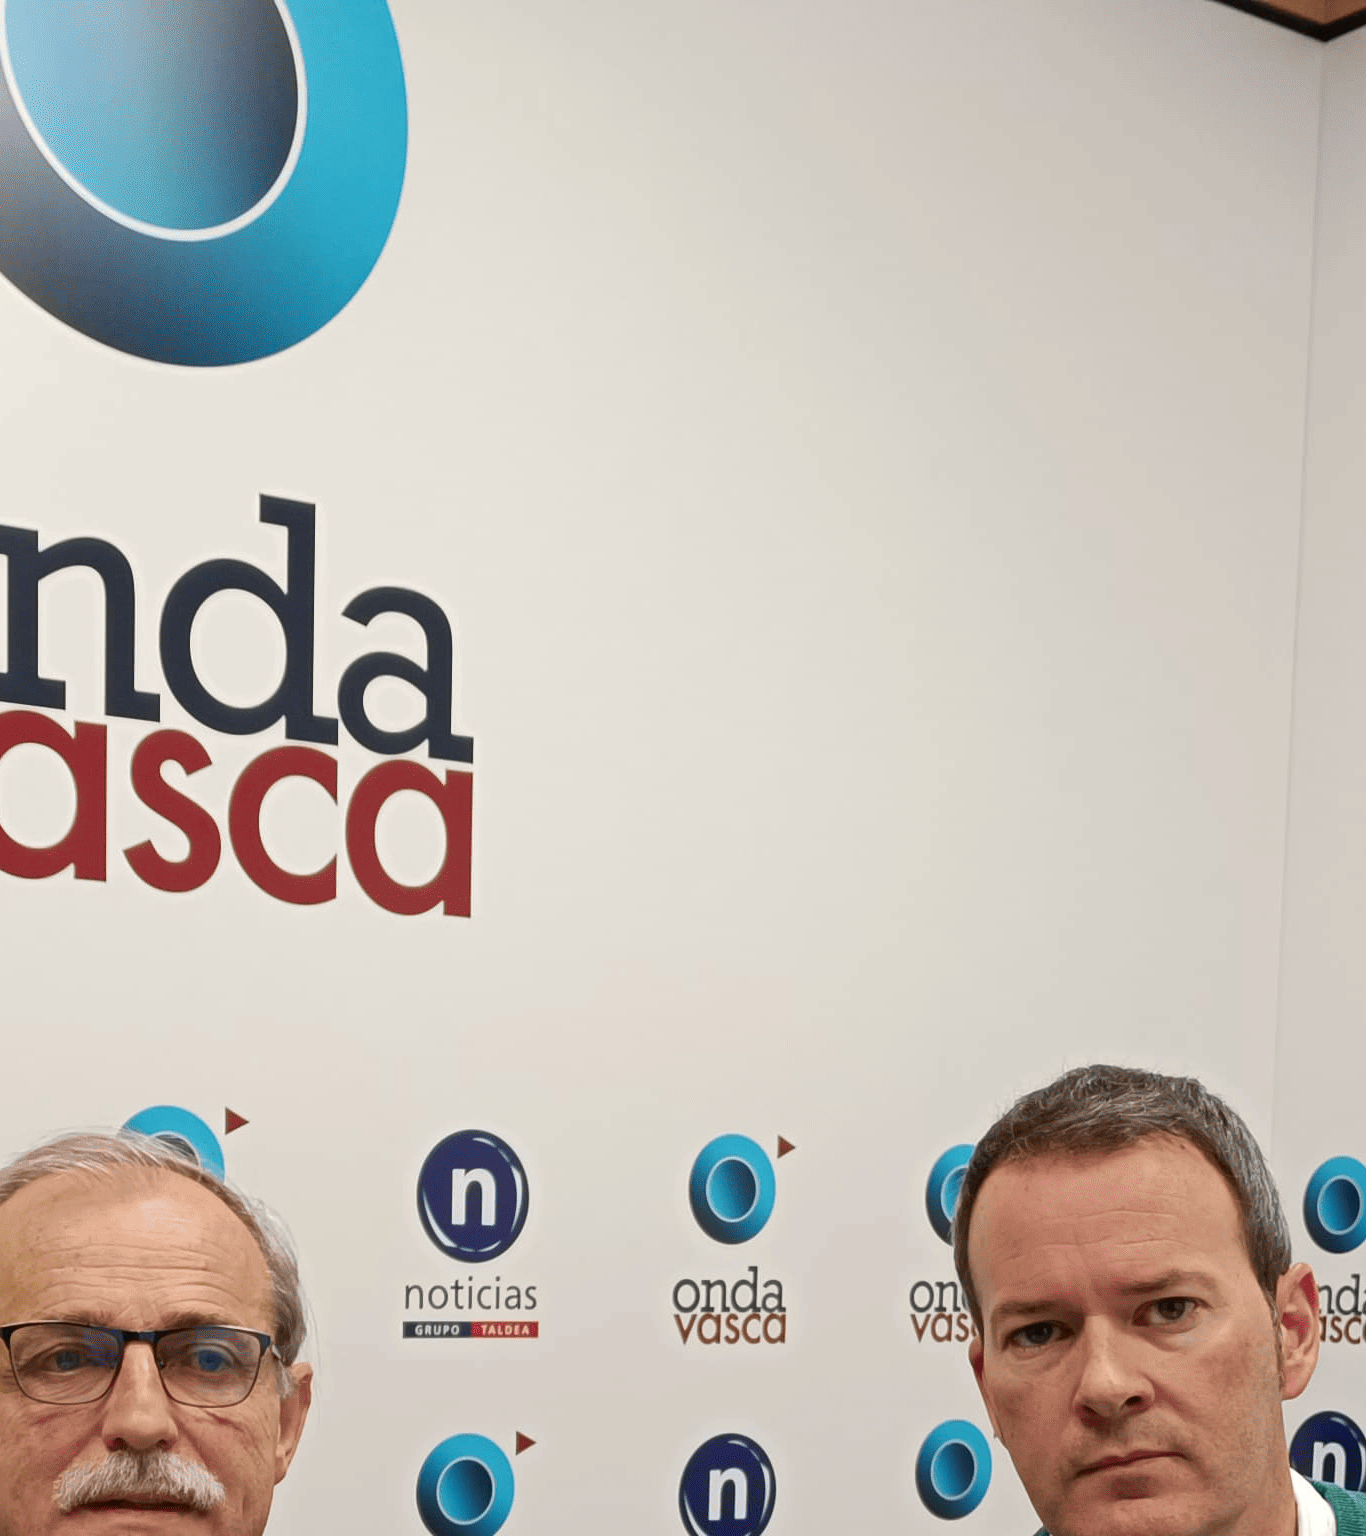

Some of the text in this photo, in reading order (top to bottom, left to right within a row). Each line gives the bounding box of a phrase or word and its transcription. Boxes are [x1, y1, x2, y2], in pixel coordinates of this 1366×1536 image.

[404, 1276, 537, 1311] noticias
[673, 1266, 787, 1313] onda
[910, 1280, 968, 1313] on
[414, 1323, 530, 1337] GRUPO TALDEA
[674, 1312, 787, 1345] vasca
[910, 1312, 977, 1343] vas
